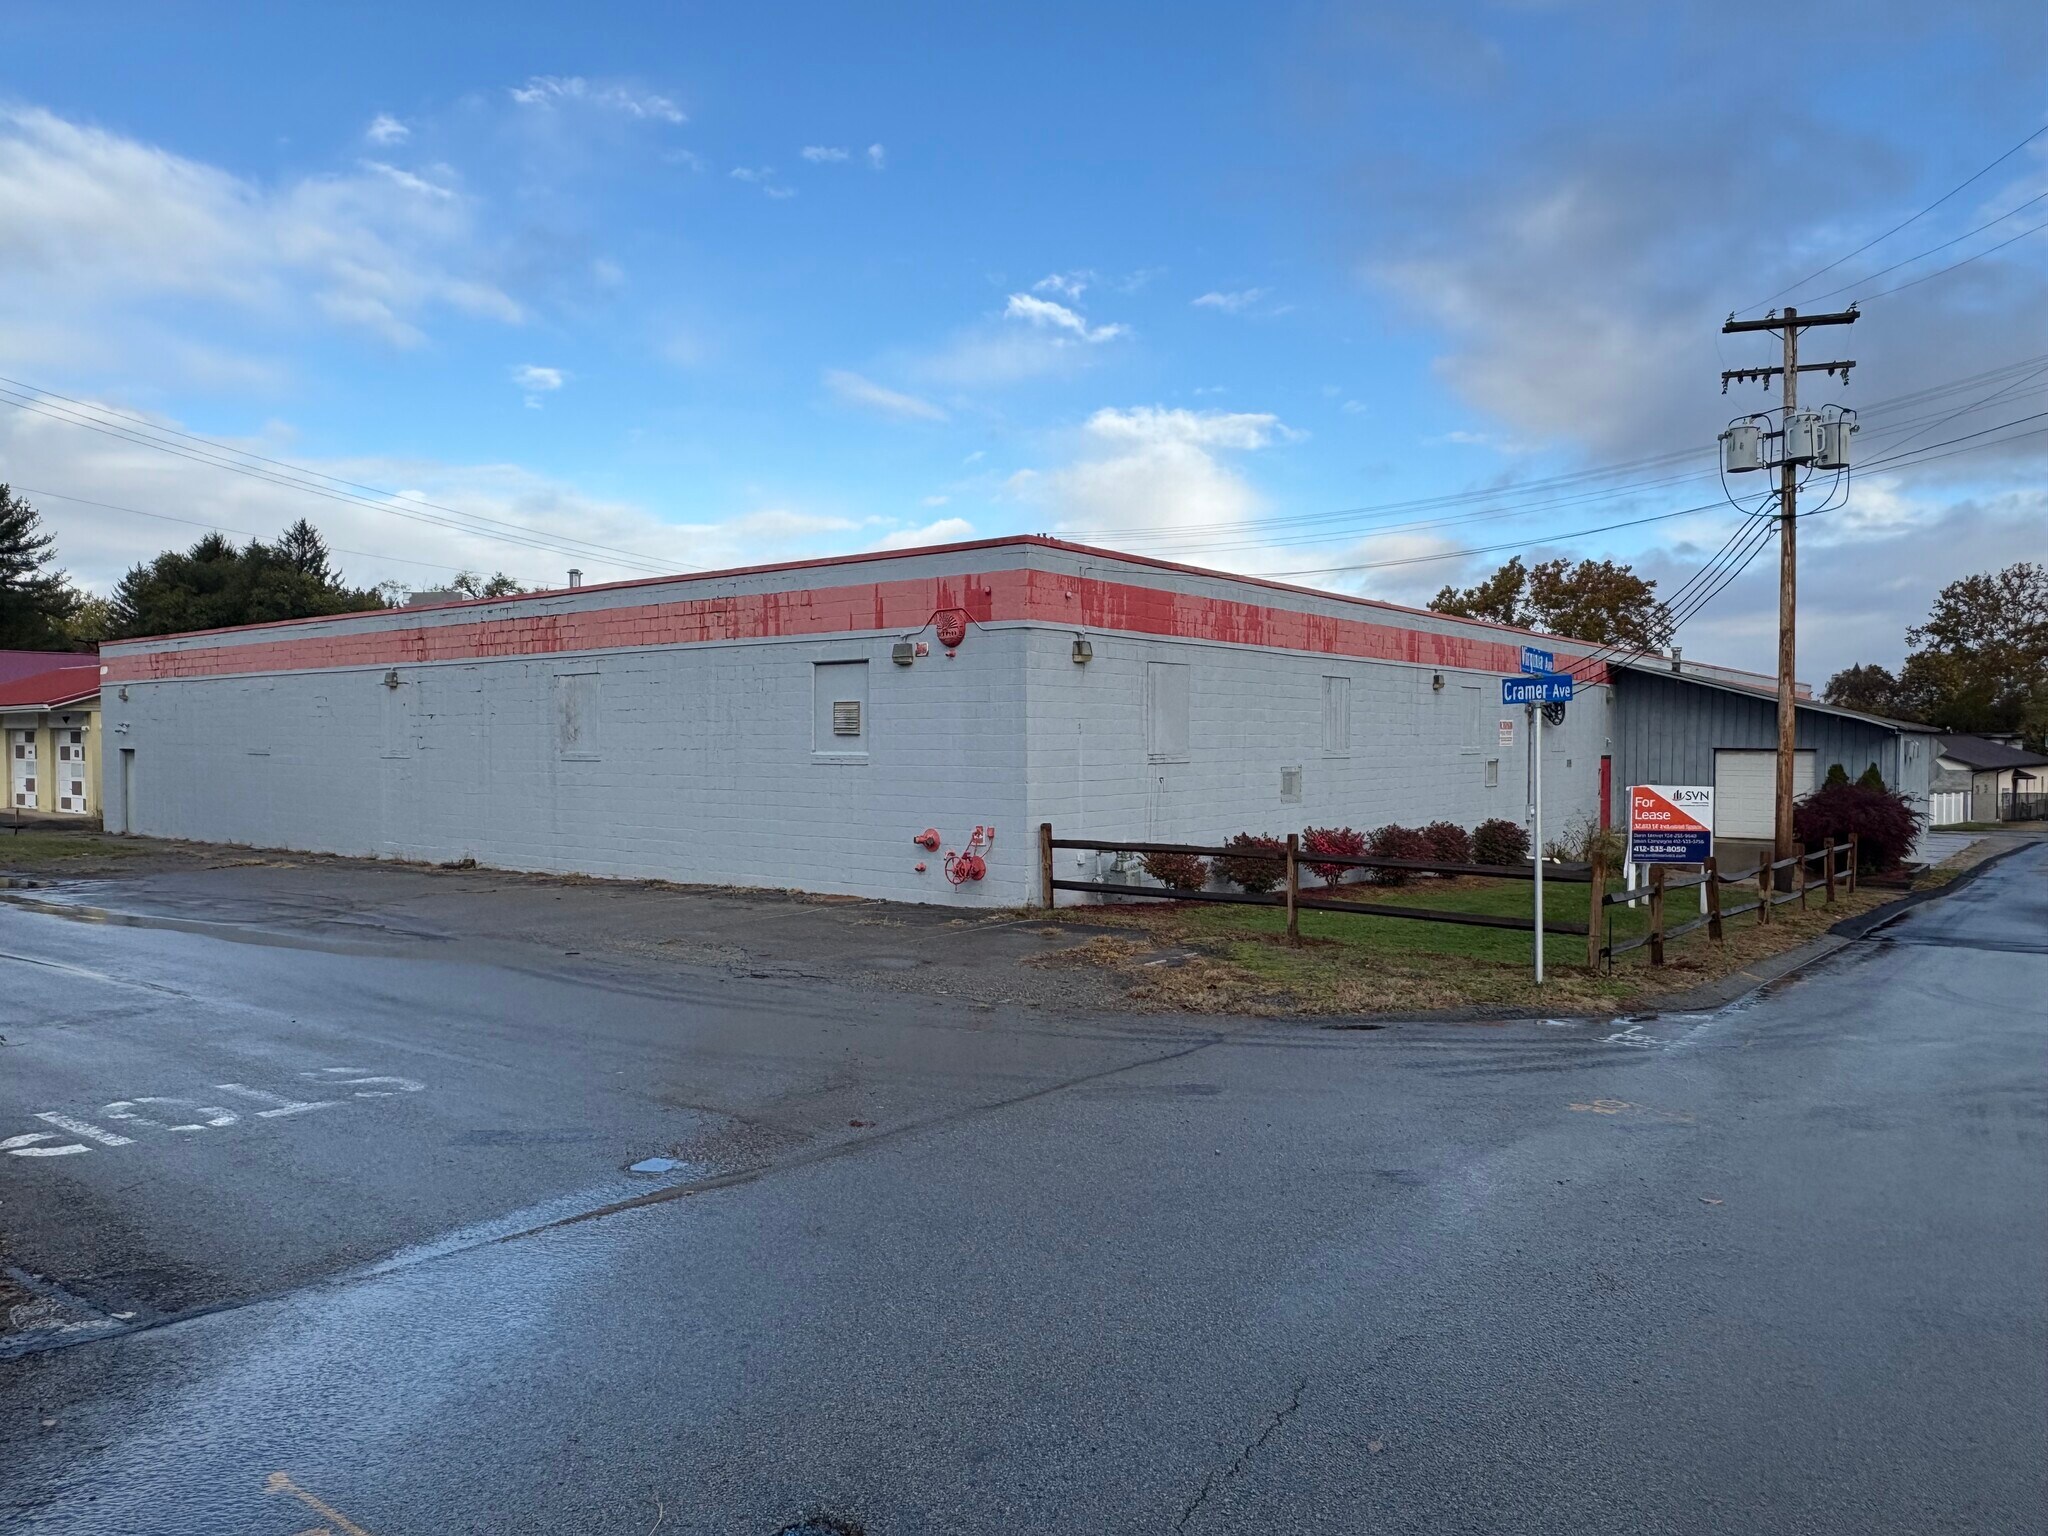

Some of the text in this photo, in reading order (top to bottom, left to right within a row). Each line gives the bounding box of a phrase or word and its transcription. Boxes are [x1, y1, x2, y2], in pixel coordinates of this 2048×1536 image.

[1522, 646, 1543, 673] Virginia
[1504, 682, 1571, 701] Cramer Ave
[1685, 790, 1709, 801] SVN
[1635, 796, 1656, 808] For
[1635, 809, 1671, 820] Lease
